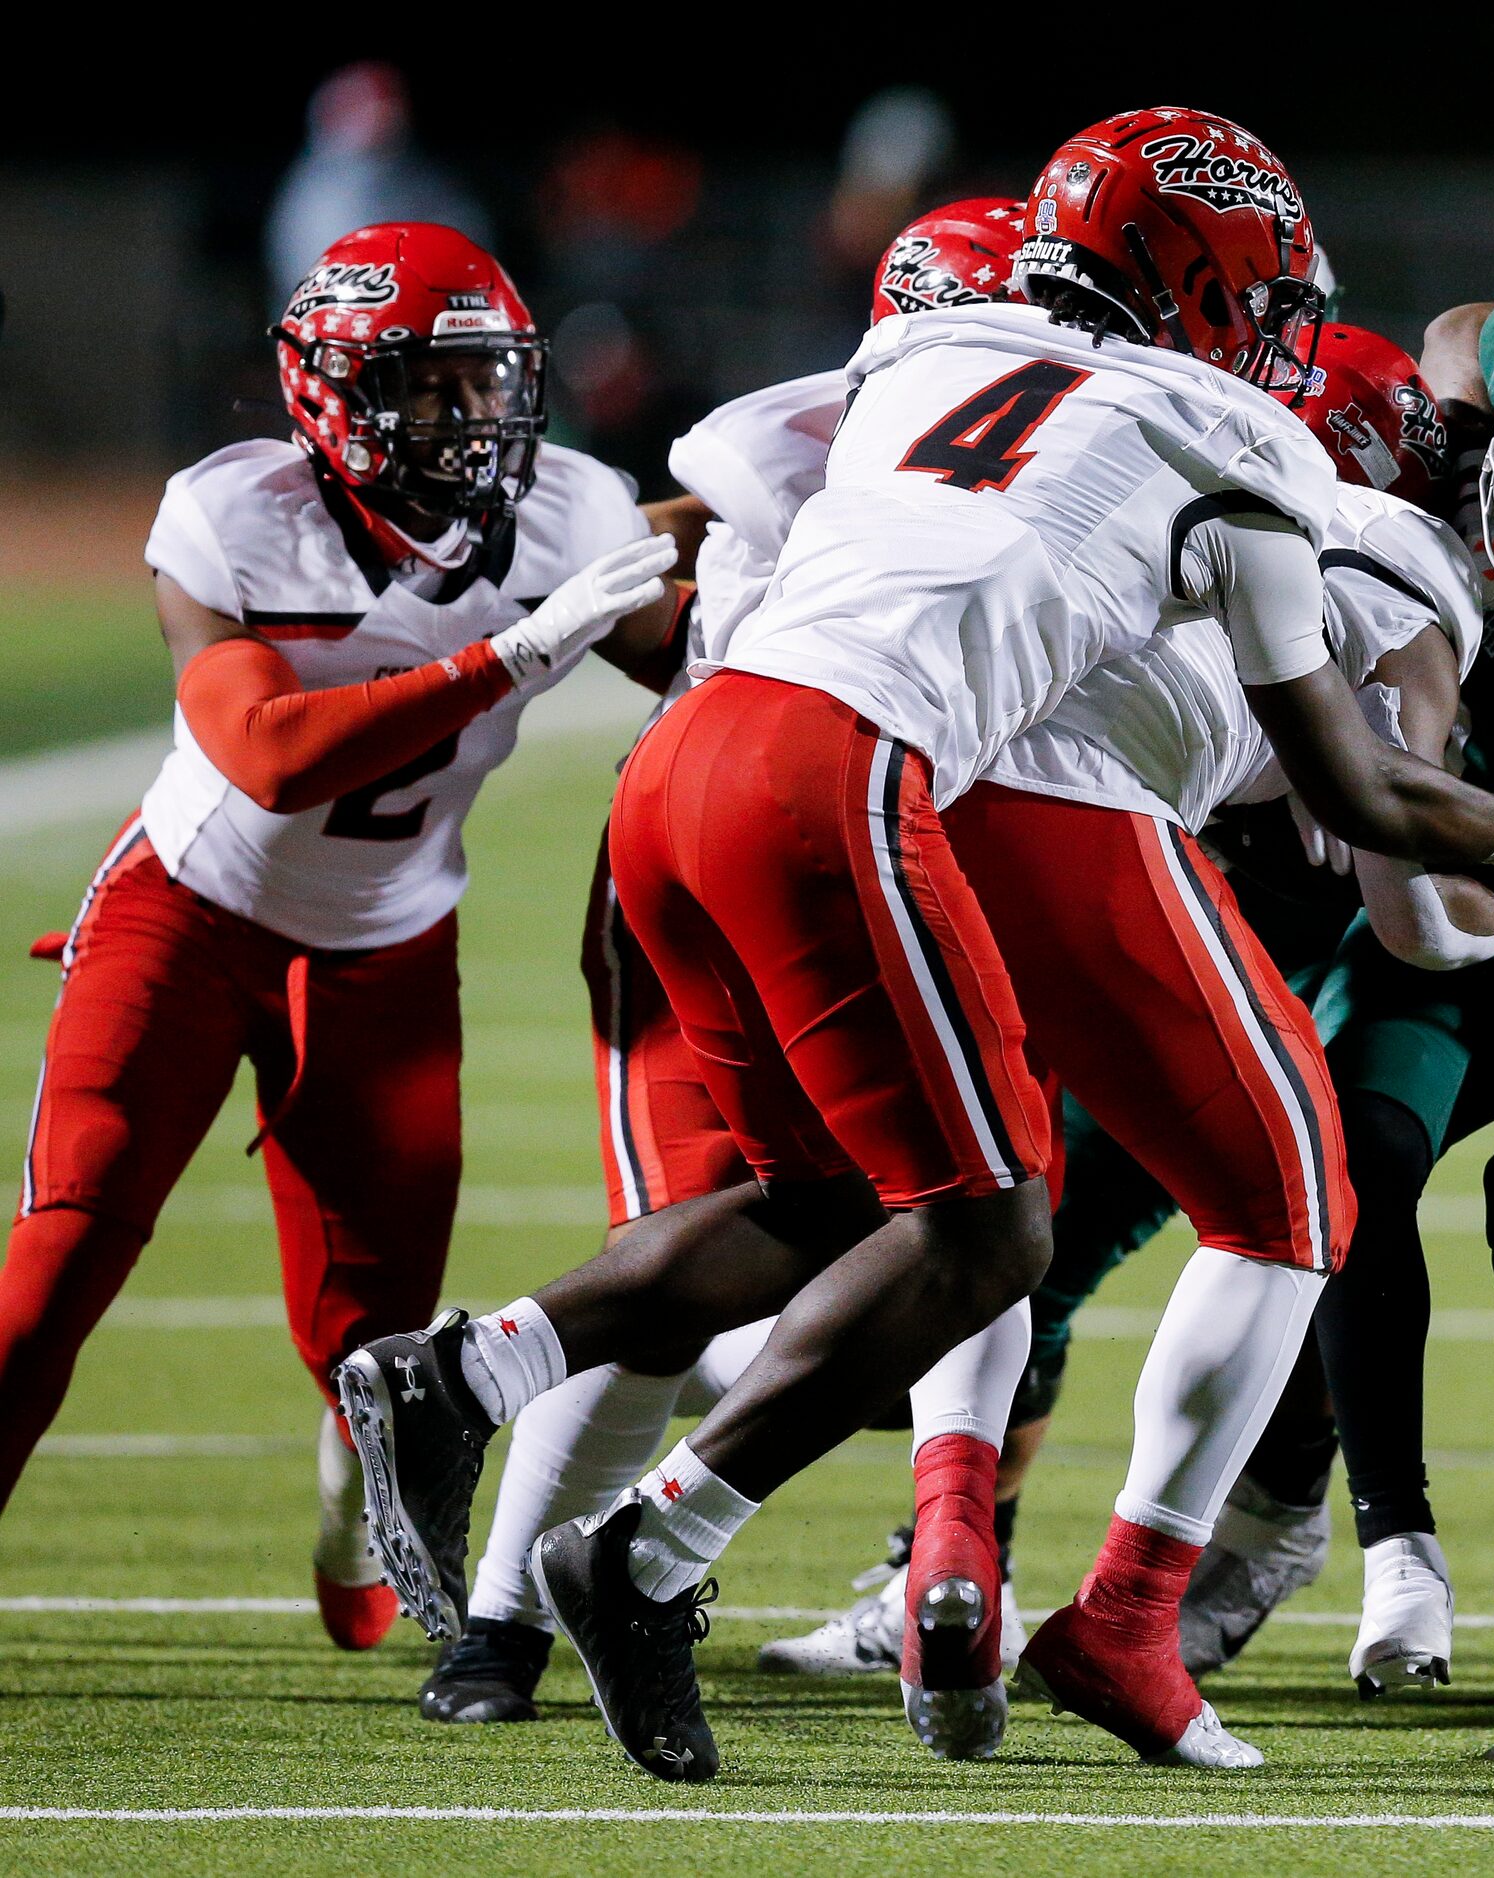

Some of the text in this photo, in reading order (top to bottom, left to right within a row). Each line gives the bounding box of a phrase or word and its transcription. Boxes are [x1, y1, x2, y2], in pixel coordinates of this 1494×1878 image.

[1139, 134, 1302, 223] Horns
[1020, 235, 1072, 263] schutt
[894, 359, 1096, 493] 4
